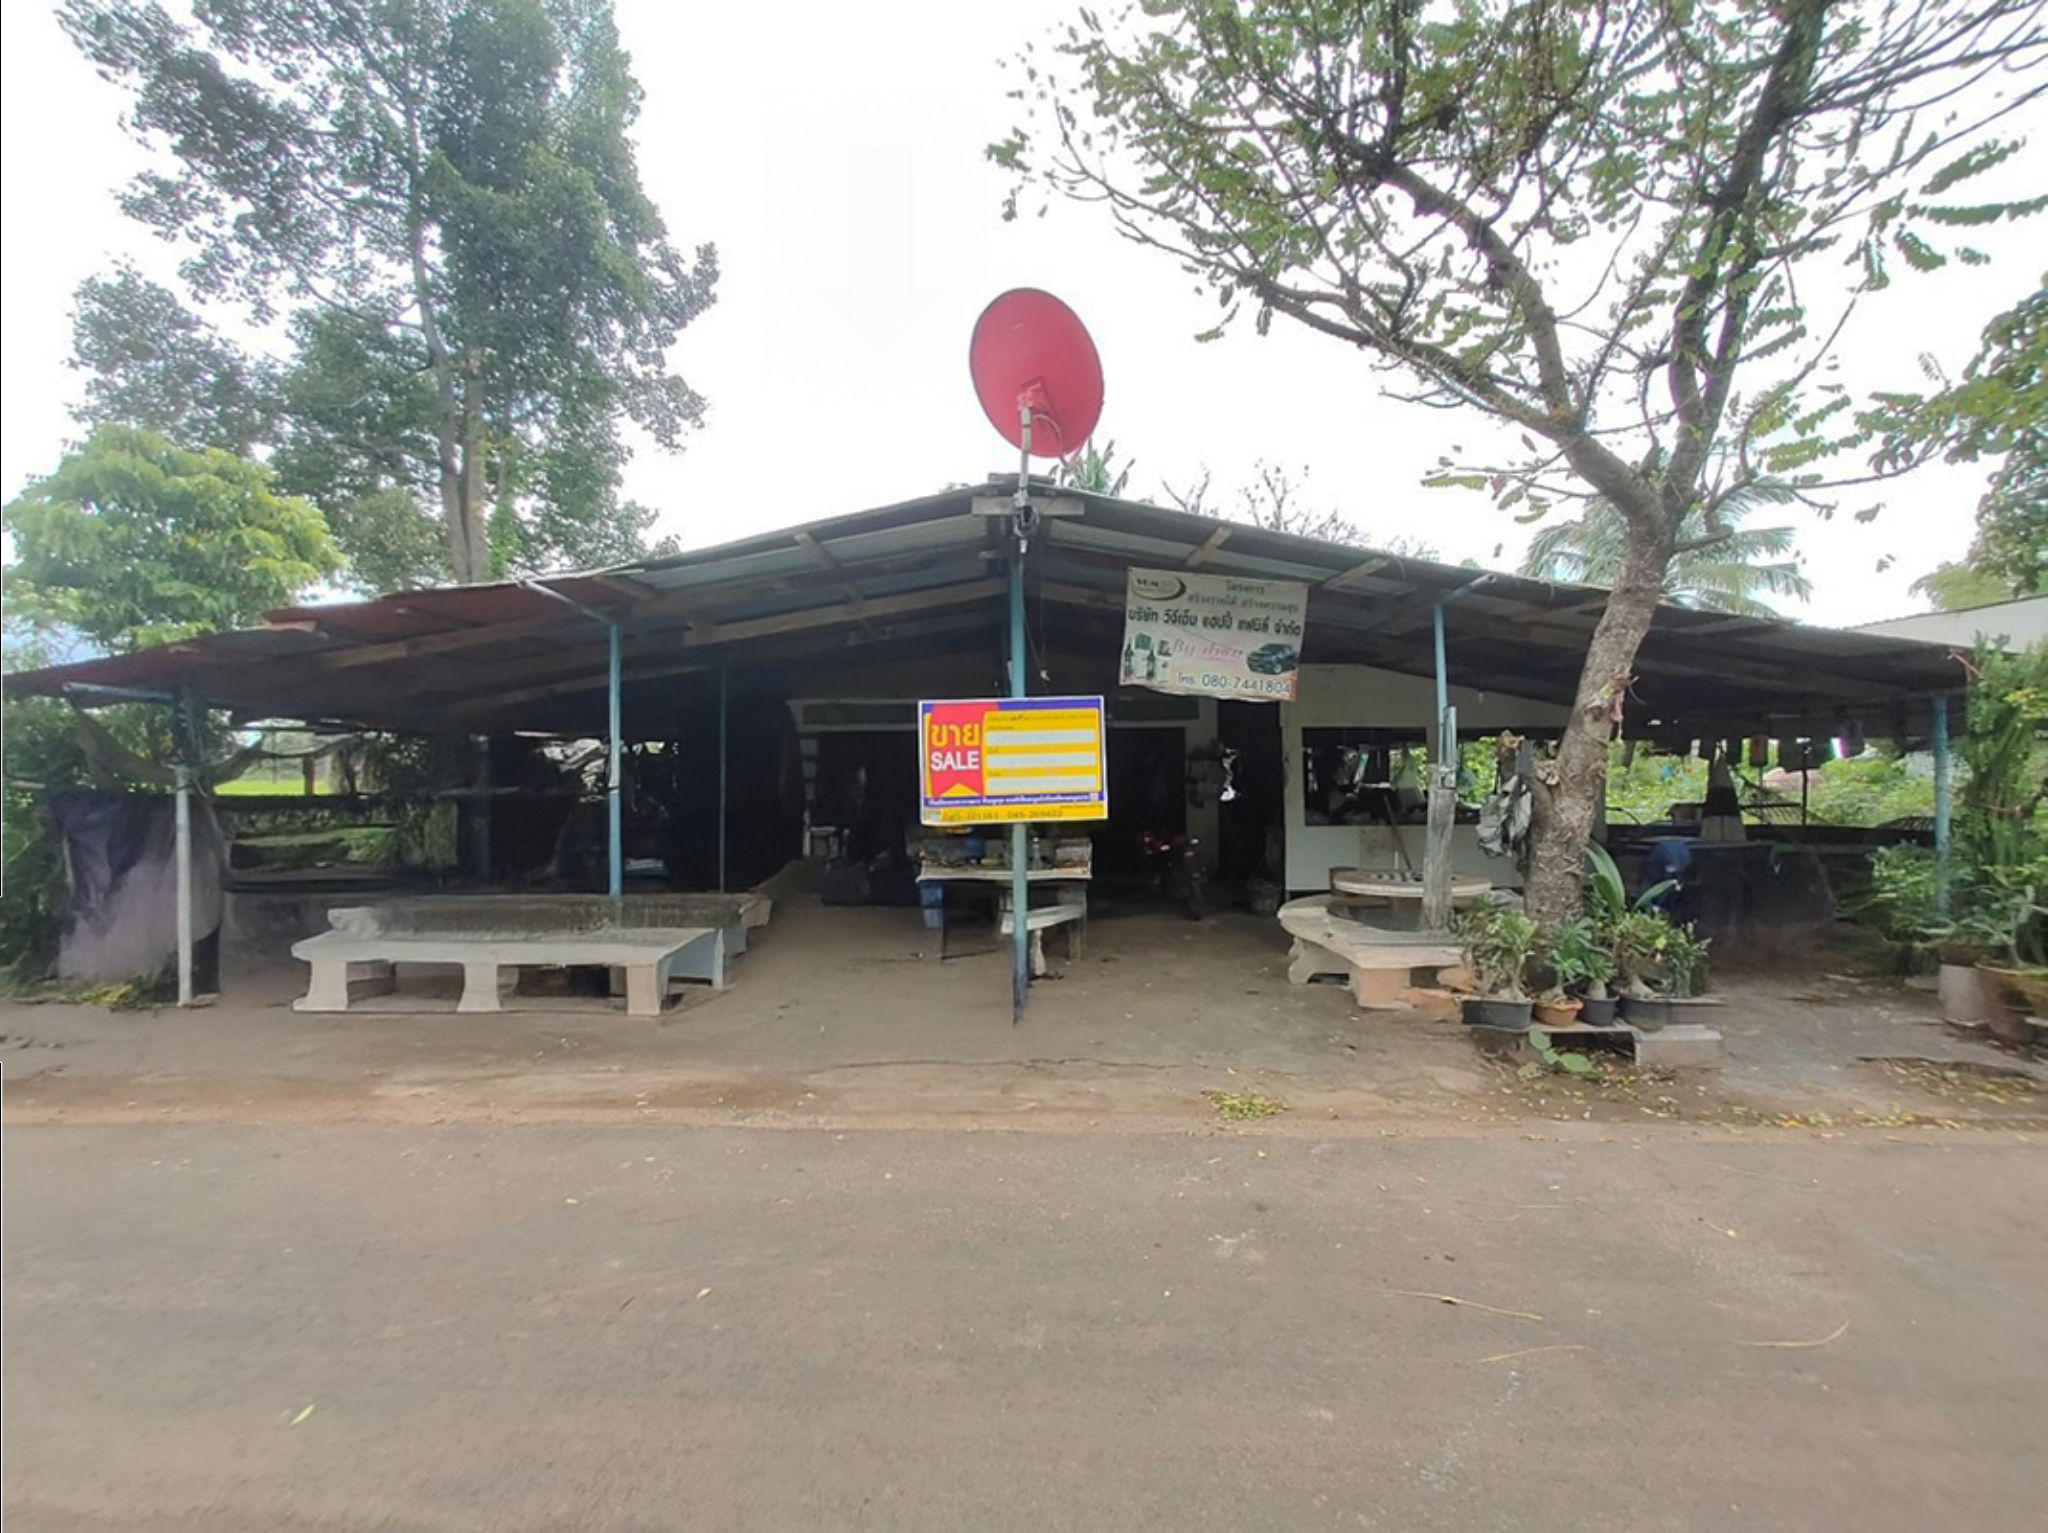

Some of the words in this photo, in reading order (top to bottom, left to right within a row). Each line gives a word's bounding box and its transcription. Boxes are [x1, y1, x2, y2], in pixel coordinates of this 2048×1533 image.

[1128, 607, 1159, 622] บริษัท
[1274, 618, 1302, 636] จำกัด
[930, 723, 981, 747] ขาย
[930, 748, 981, 771] SALE
